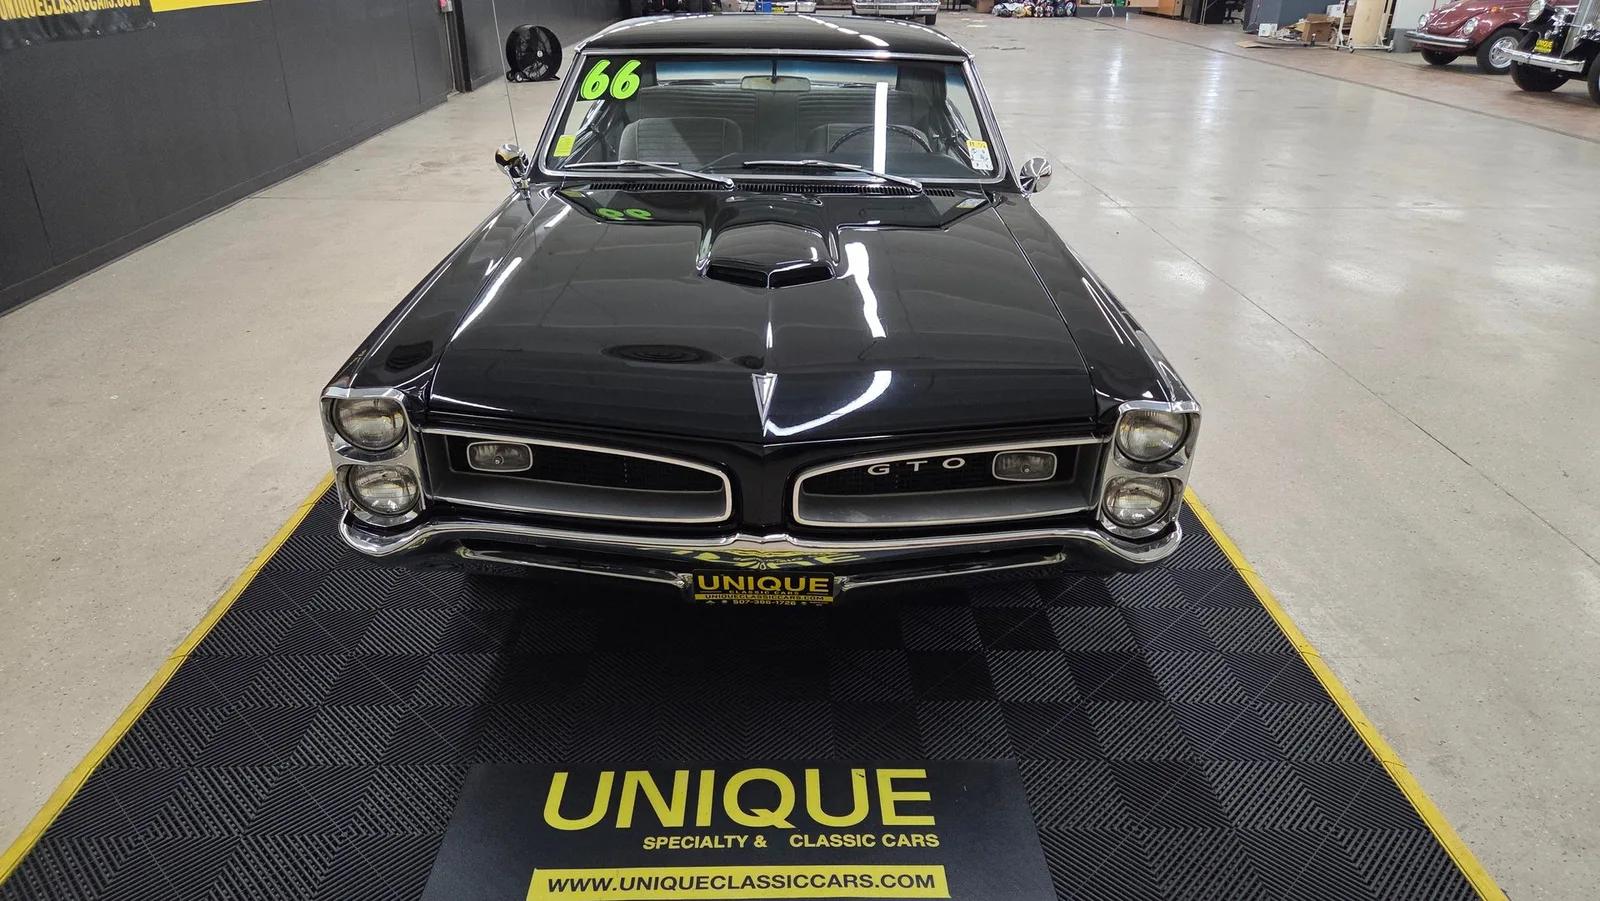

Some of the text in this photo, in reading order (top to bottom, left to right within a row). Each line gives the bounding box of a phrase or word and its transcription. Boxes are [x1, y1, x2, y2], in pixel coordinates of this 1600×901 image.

[580, 59, 642, 100] 66
[867, 457, 966, 476] GTO
[697, 575, 829, 593] UNIQUE
[543, 768, 936, 830] UNIQUE
[642, 833, 940, 850] SPECIALTY & CLASSIC CARS
[548, 873, 936, 893] WWW.UNIQUECLASSICCARS.COM
